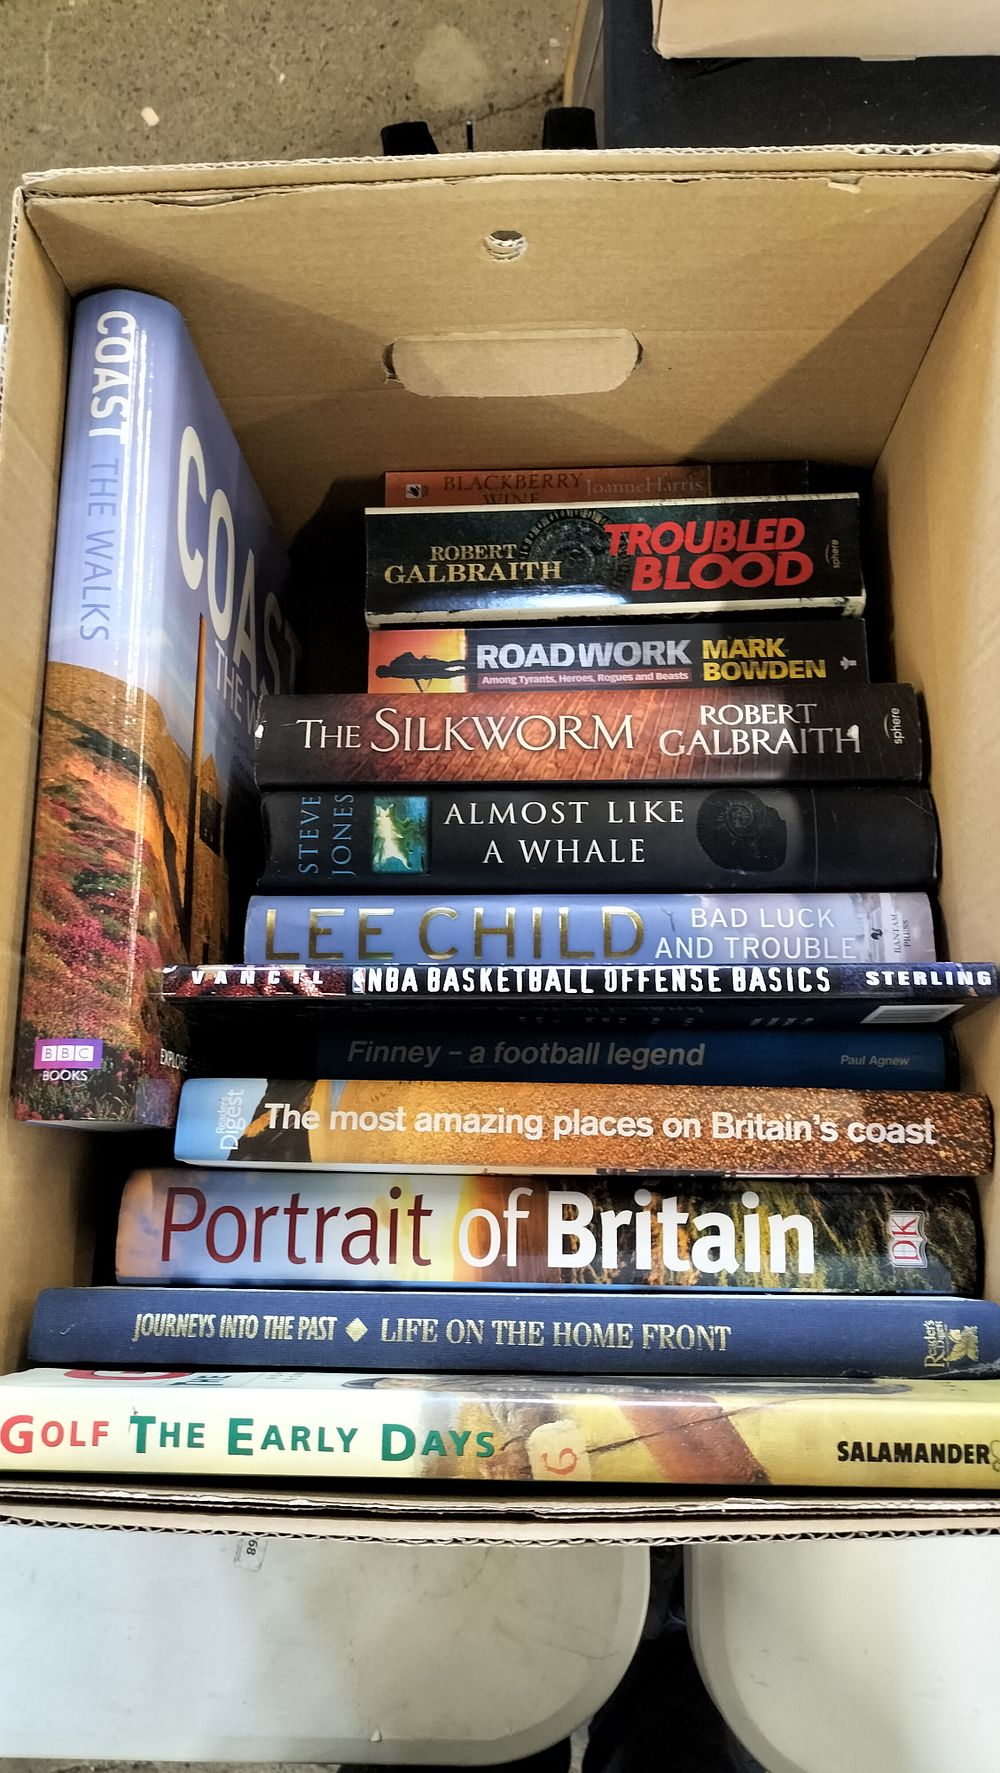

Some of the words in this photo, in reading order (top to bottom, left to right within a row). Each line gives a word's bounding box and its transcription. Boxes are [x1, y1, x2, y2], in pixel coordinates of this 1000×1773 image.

[88, 310, 138, 446] COAST
[87, 457, 120, 517] THE
[442, 472, 584, 492] BLACKBERRY
[603, 517, 806, 557] TROUBLED
[430, 543, 518, 562] ROBERT
[830, 539, 841, 569] sphere
[79, 528, 115, 642] WALKS
[384, 560, 563, 585] GALBRAITH
[631, 551, 815, 591] BLOOD
[702, 638, 787, 660] MARK
[214, 638, 243, 723] THE
[481, 674, 518, 686] Among
[519, 673, 558, 685] Tyrants,
[558, 673, 596, 684] Heroes,
[597, 672, 632, 685] Rogues
[635, 672, 655, 682] and
[655, 672, 689, 682] Beasts
[703, 659, 827, 682] BOWDEN
[700, 703, 817, 726] ROBERT
[893, 706, 904, 746] sphere
[296, 718, 361, 750] THE
[371, 707, 635, 753] SILKWORM
[659, 724, 862, 757] GALBRAITH
[443, 800, 589, 826] ALMOST
[607, 800, 685, 825] LIKE
[298, 795, 321, 875] STEVE
[331, 793, 358, 880] JONES
[482, 839, 505, 864] A
[518, 838, 646, 864] WHALE
[691, 907, 748, 929] BAD
[760, 907, 836, 929] LUCK
[265, 908, 395, 961] LEE
[418, 906, 645, 961] CHILD
[655, 936, 714, 959] AND
[724, 936, 857, 960] TROUBLE
[891, 914, 902, 955] BANTAM
[192, 969, 324, 986] VANCIL
[368, 965, 418, 993] NBA
[427, 966, 594, 995] BASKETBALL
[604, 967, 722, 993] OFFENSE
[732, 967, 832, 993] BASICS
[865, 969, 993, 988] STERLING
[43, 1047, 92, 1060] BBC
[347, 1040, 443, 1070] Finney
[469, 1047, 484, 1065] a
[493, 1040, 600, 1067] football
[606, 1042, 706, 1071] legend
[840, 1055, 867, 1066] Paul
[870, 1056, 911, 1068] Agnew
[41, 1069, 89, 1082] BOOKS
[220, 1089, 247, 1150] Digest
[264, 1103, 320, 1130] The
[329, 1106, 406, 1131] most
[414, 1106, 543, 1141] amazing
[553, 1108, 654, 1141] places
[663, 1117, 700, 1139] on
[712, 1111, 838, 1143] Britain's
[846, 1117, 937, 1145] coast
[161, 1186, 433, 1266] Portrait
[458, 1187, 534, 1268] of
[547, 1188, 816, 1275] Britain
[892, 1218, 920, 1262] DK
[132, 1313, 216, 1342] JOURNEYS
[219, 1314, 259, 1339] INTO
[263, 1315, 295, 1340] THE
[297, 1316, 338, 1341] PAST
[380, 1317, 439, 1343] LIFE
[445, 1318, 485, 1344] ON
[491, 1319, 545, 1347] THE
[552, 1321, 633, 1349] HOME
[642, 1323, 731, 1351] FRONT
[0, 1415, 109, 1454] GOLF
[130, 1415, 205, 1454] THE
[228, 1417, 358, 1456] EARLY
[381, 1423, 495, 1461] DAYS
[837, 1440, 990, 1465] SALAMANDER
